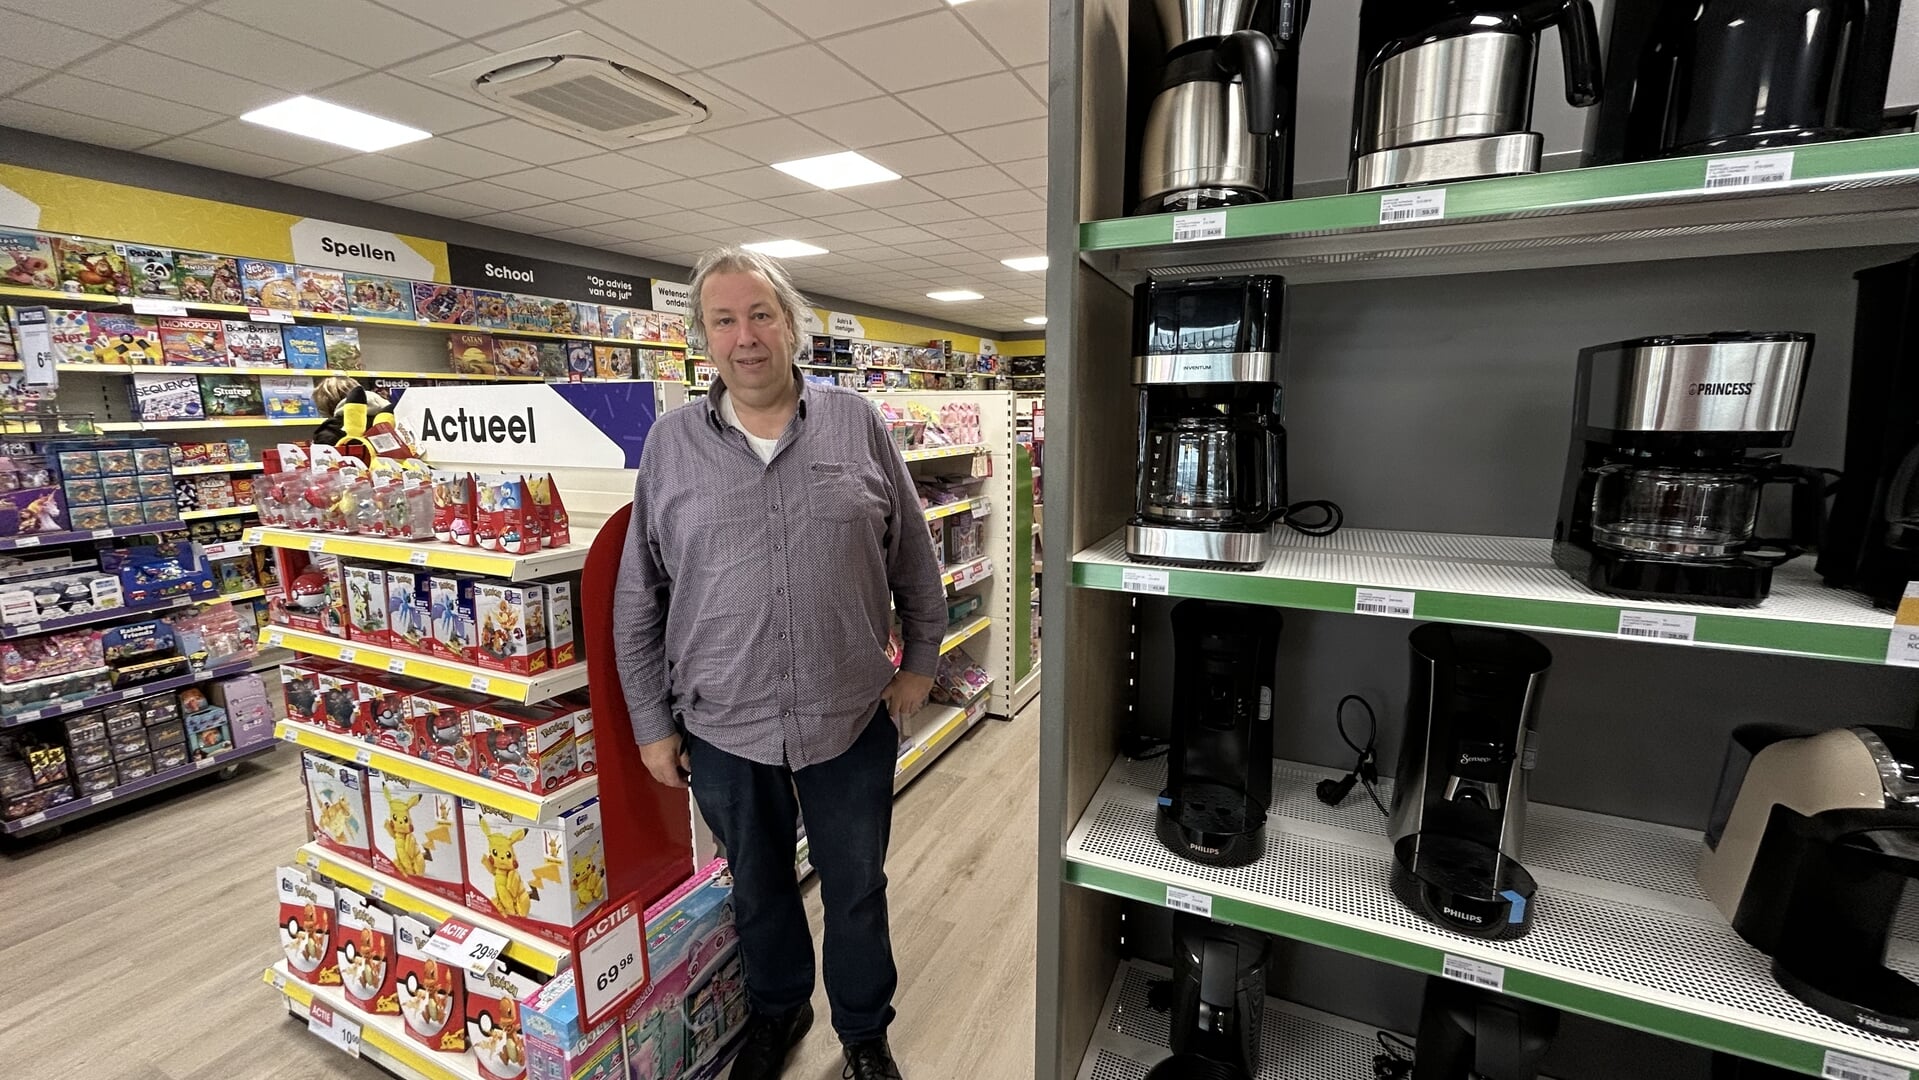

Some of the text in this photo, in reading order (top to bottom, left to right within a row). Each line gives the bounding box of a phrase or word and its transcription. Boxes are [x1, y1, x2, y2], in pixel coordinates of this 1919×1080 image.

[321, 237, 396, 263] Spellen
[485, 263, 535, 283] School
[606, 278, 632, 291] advies
[589, 288, 605, 297] van
[606, 289, 617, 299] de
[162, 320, 219, 330] MONOPOLY
[461, 335, 483, 345] CATAN
[1183, 363, 1212, 373] INVENTUM
[137, 378, 198, 397] SEQUENCE
[375, 379, 411, 388] Cluedo
[1697, 382, 1753, 396] PRINCESS
[421, 406, 537, 443] Actueel
[1190, 843, 1220, 856] PHILIPS
[1443, 906, 1483, 924] PHILIPS
[440, 922, 469, 940] ACTIE
[585, 903, 630, 944] ACTIE
[311, 1004, 332, 1023] ACTIE
